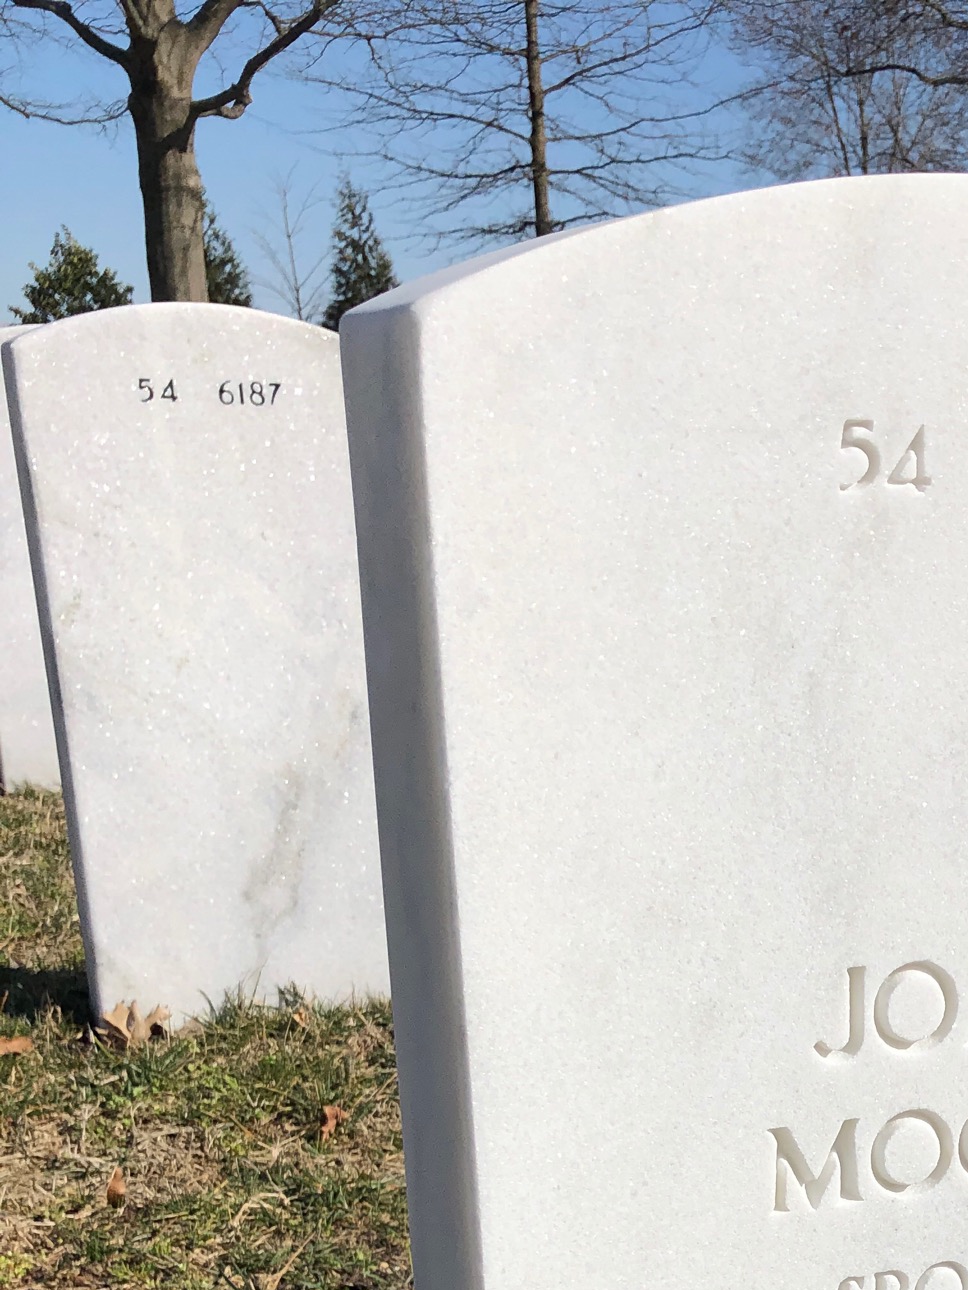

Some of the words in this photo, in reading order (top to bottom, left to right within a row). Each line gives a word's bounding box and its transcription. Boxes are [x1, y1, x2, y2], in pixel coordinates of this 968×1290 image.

[138, 378, 178, 402] 54
[218, 381, 281, 406] 6187
[839, 418, 932, 492] 54
